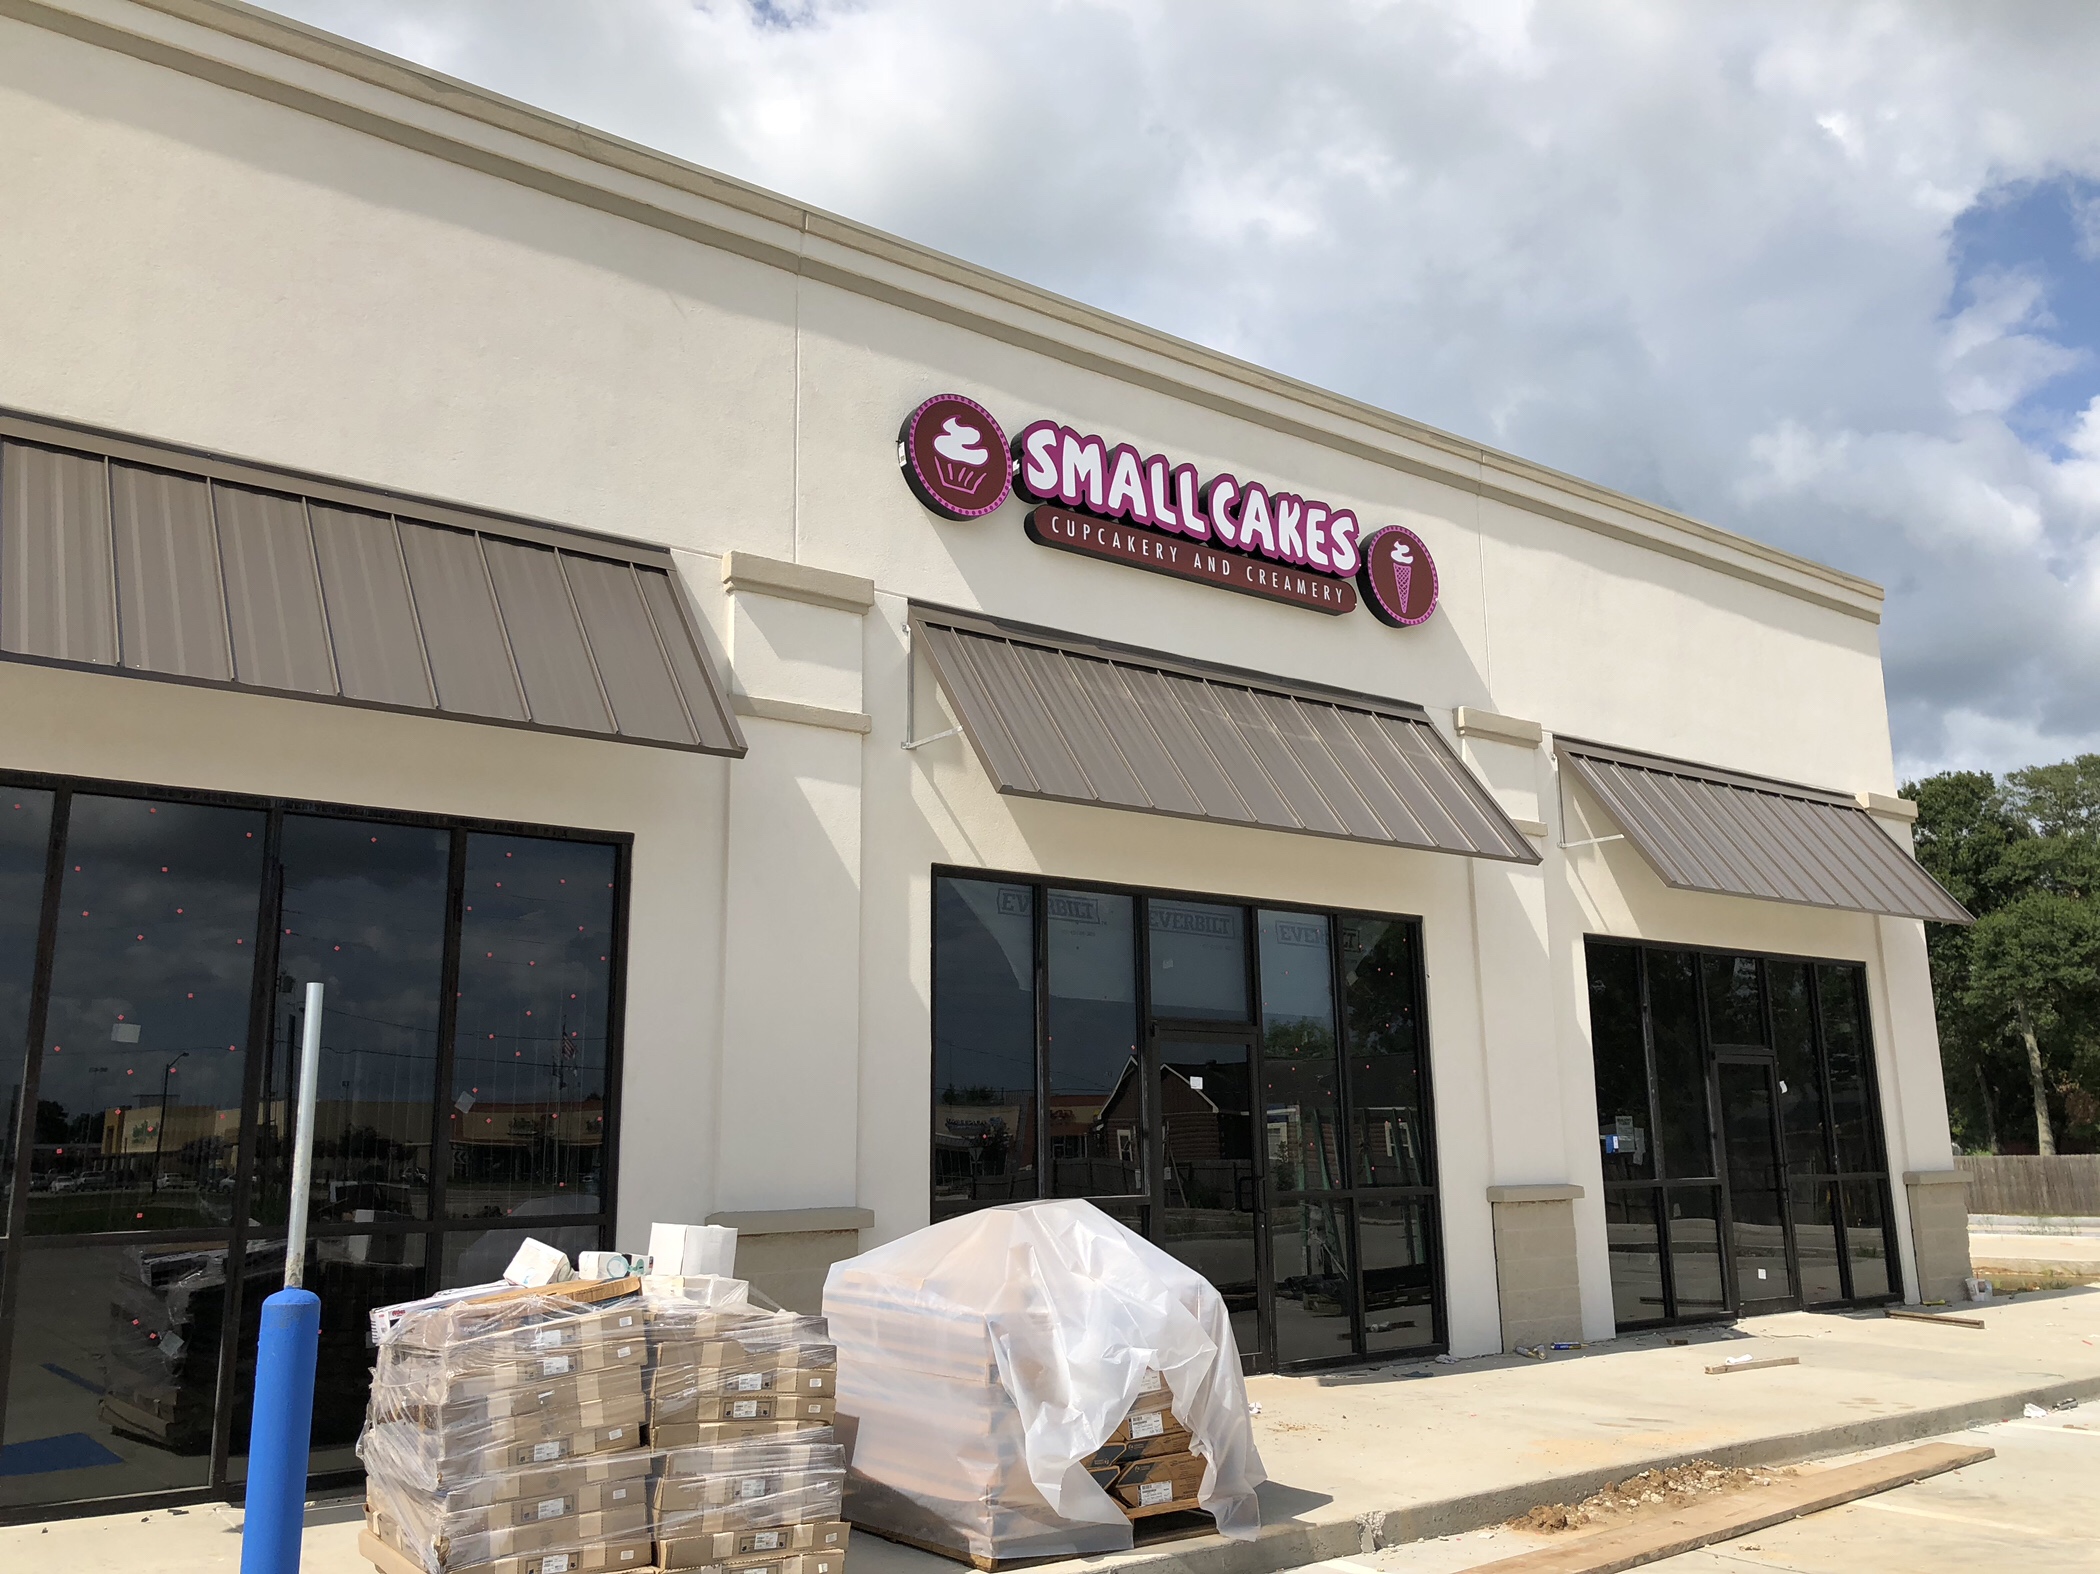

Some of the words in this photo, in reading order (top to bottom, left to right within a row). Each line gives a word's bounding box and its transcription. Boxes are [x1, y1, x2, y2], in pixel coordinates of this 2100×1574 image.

[1022, 420, 1360, 577] SMALLCAKES
[1052, 516, 1177, 562] CUPCAKERY
[1194, 553, 1230, 576] AND
[1246, 566, 1342, 603] CREAMERY
[1001, 892, 1095, 920] EVBILT
[1149, 910, 1231, 934] EVERBILT
